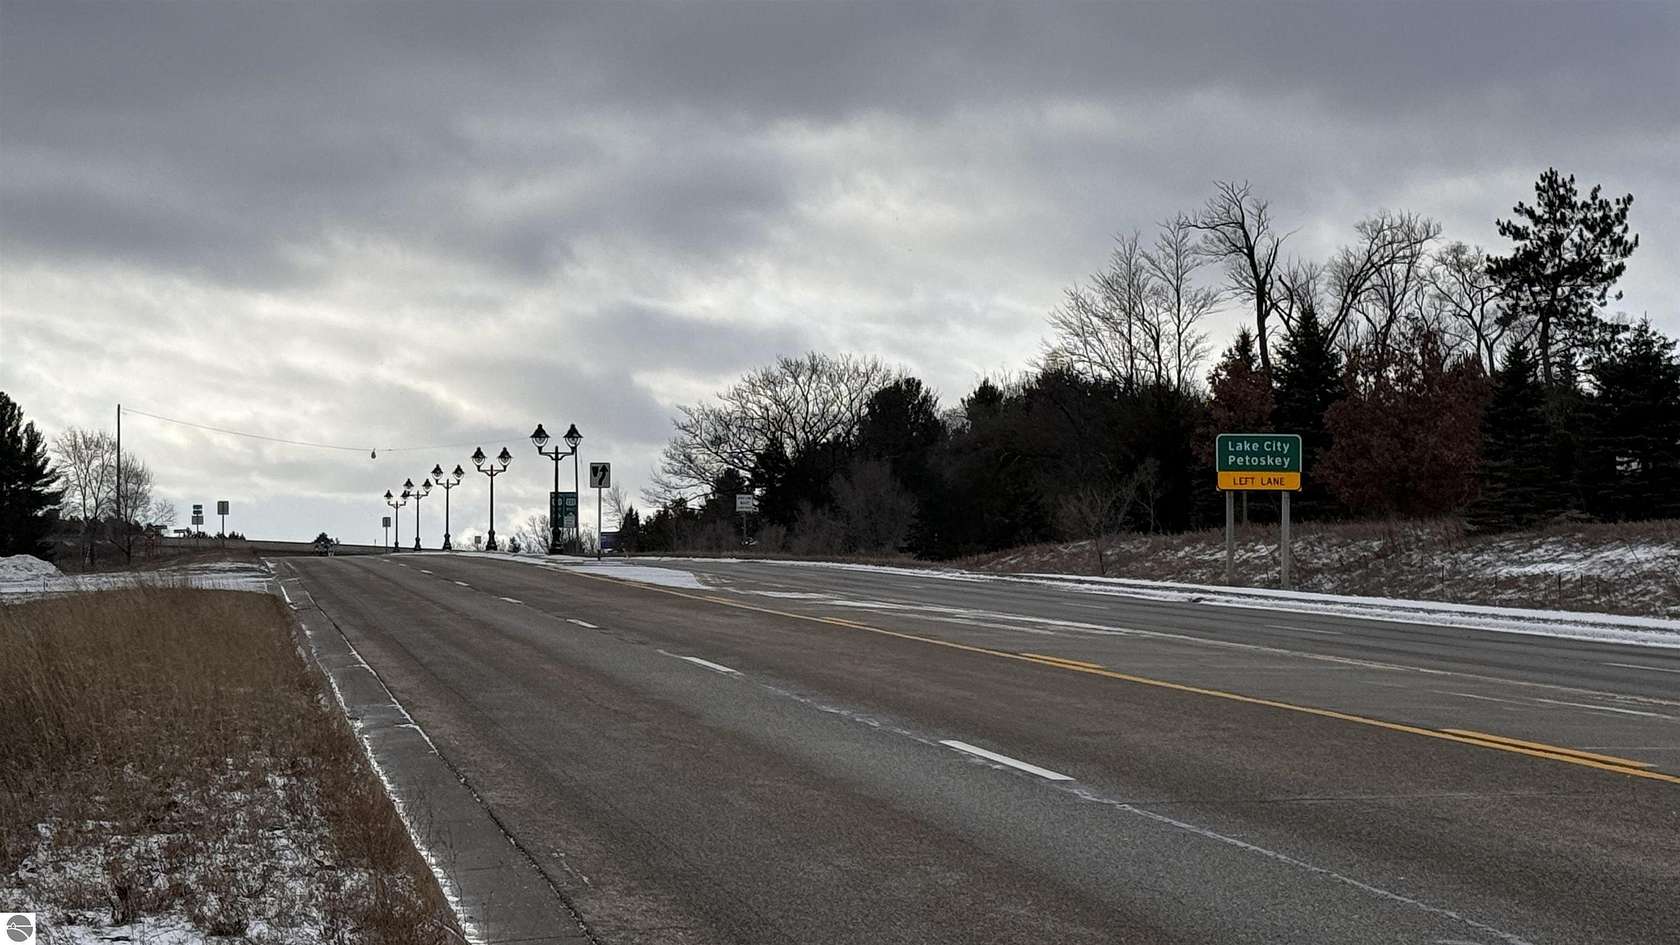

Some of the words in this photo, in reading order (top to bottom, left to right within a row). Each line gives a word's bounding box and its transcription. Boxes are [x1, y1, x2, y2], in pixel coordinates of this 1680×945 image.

[1228, 440, 1259, 451] Lake
[1264, 441, 1290, 454] City
[1228, 455, 1290, 468] Petoskey
[1233, 476, 1255, 486] LEFT
[1260, 476, 1285, 486] LANE
